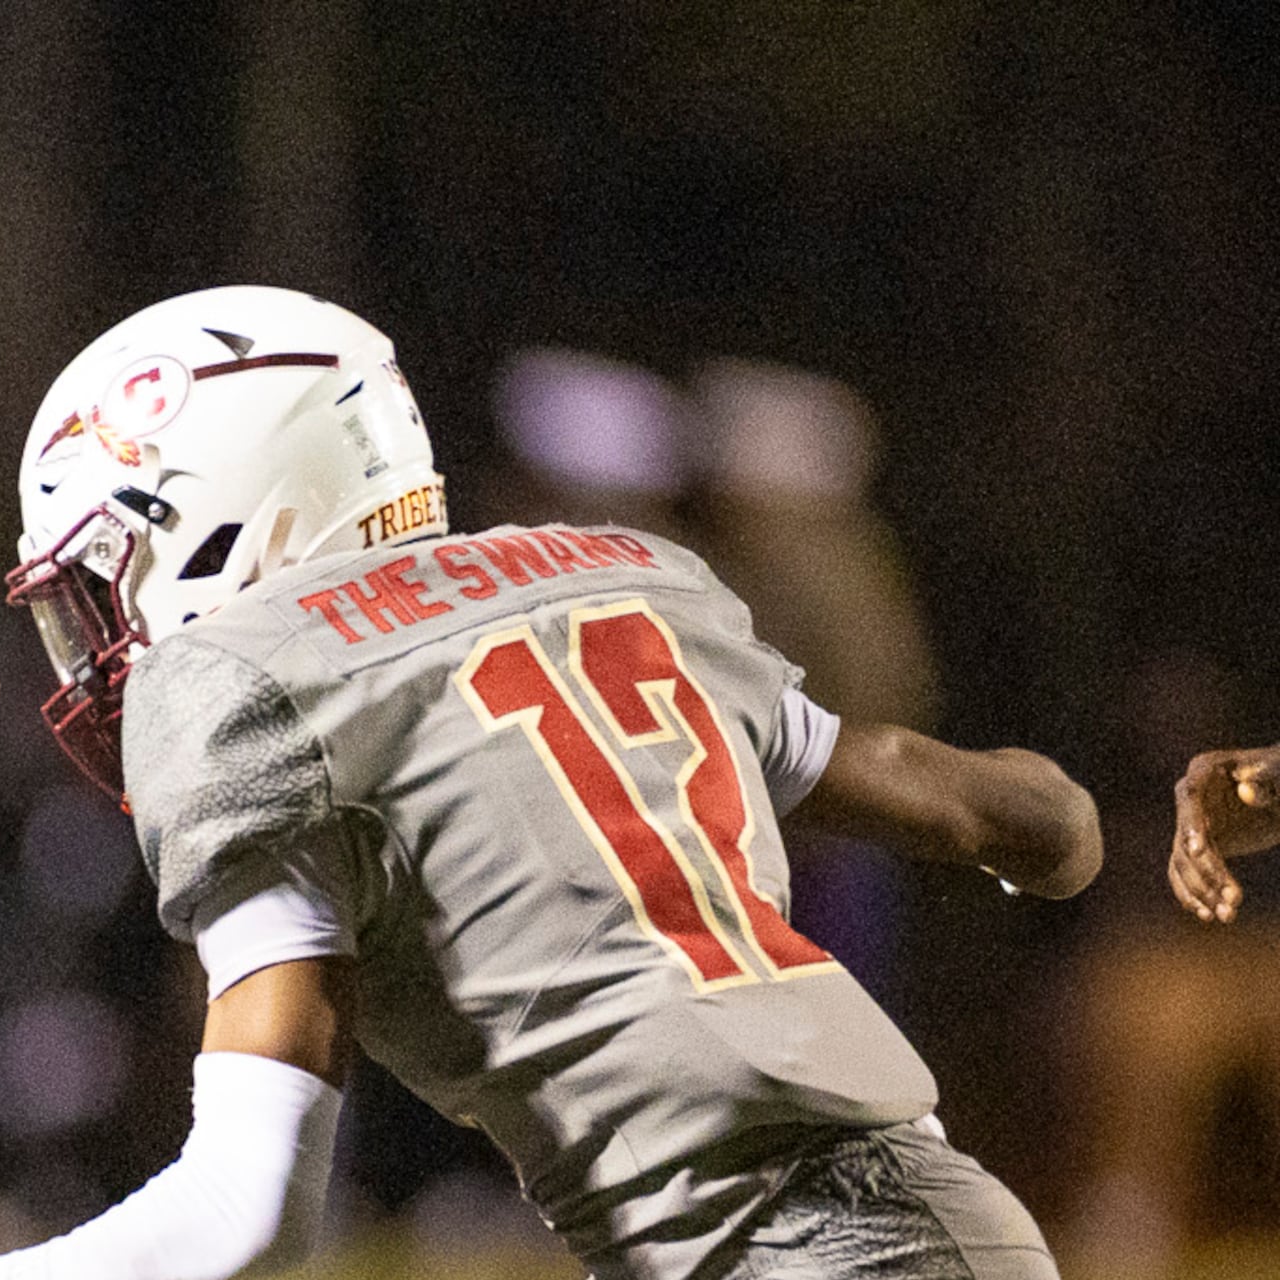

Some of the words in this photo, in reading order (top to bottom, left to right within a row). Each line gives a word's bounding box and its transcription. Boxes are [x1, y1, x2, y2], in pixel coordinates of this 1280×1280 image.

[296, 554, 455, 645] THE
[432, 530, 662, 601] SWAMP
[453, 597, 843, 993] 12
